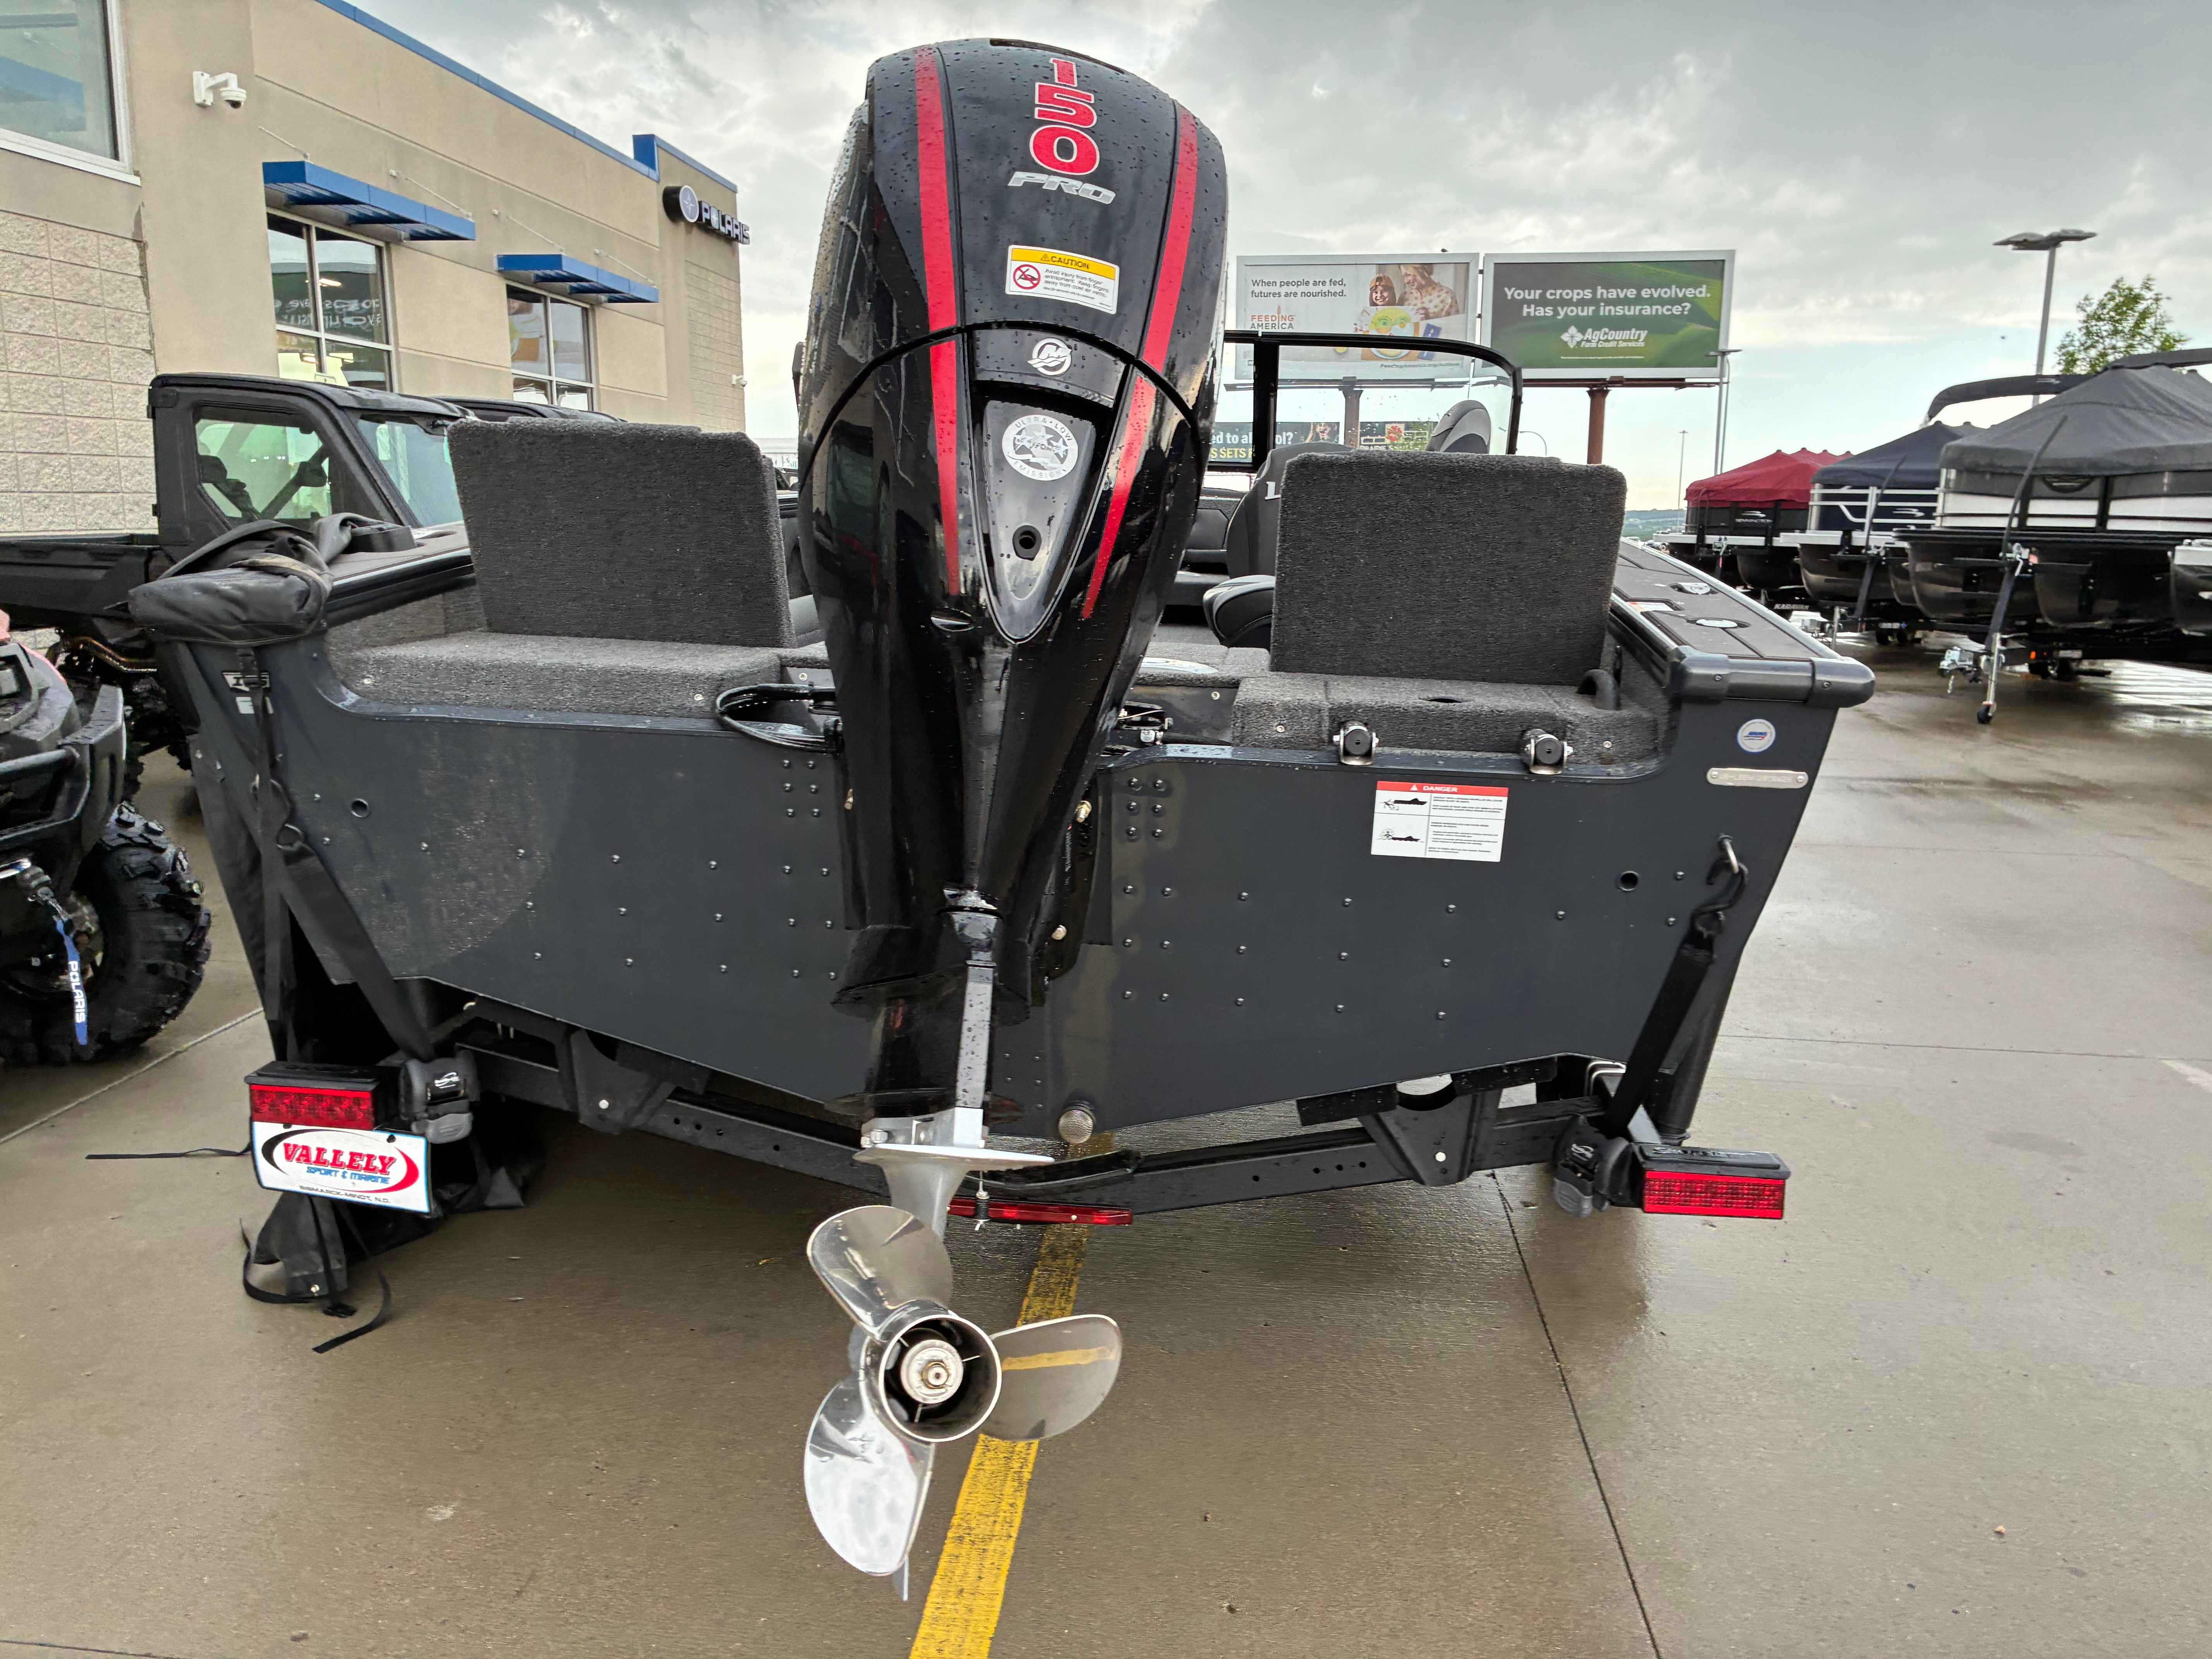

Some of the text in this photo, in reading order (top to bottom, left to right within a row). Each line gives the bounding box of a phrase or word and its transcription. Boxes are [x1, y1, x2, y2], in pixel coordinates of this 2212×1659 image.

[1029, 57, 1100, 175] 150
[1007, 171, 1116, 204] PRO
[699, 200, 750, 245] POLARIS
[1050, 256, 1090, 269] CAUTION
[1251, 279, 1277, 288] When
[1279, 278, 1310, 288] people
[1329, 278, 1346, 288] fed,
[1251, 289, 1282, 297] futures
[1300, 289, 1346, 297] nourished.
[1504, 285, 1711, 302] Your crops have evolved.
[1523, 302, 1691, 319] Has your insurance?
[1583, 328, 1648, 342] AgCountry
[1226, 433, 1239, 444] to
[1219, 448, 1247, 459] SETS
[68, 960, 86, 1023] POLARIS
[283, 1142, 397, 1176] VALLELY
[306, 1166, 338, 1178] SPORT
[350, 1172, 390, 1185] MARINE
